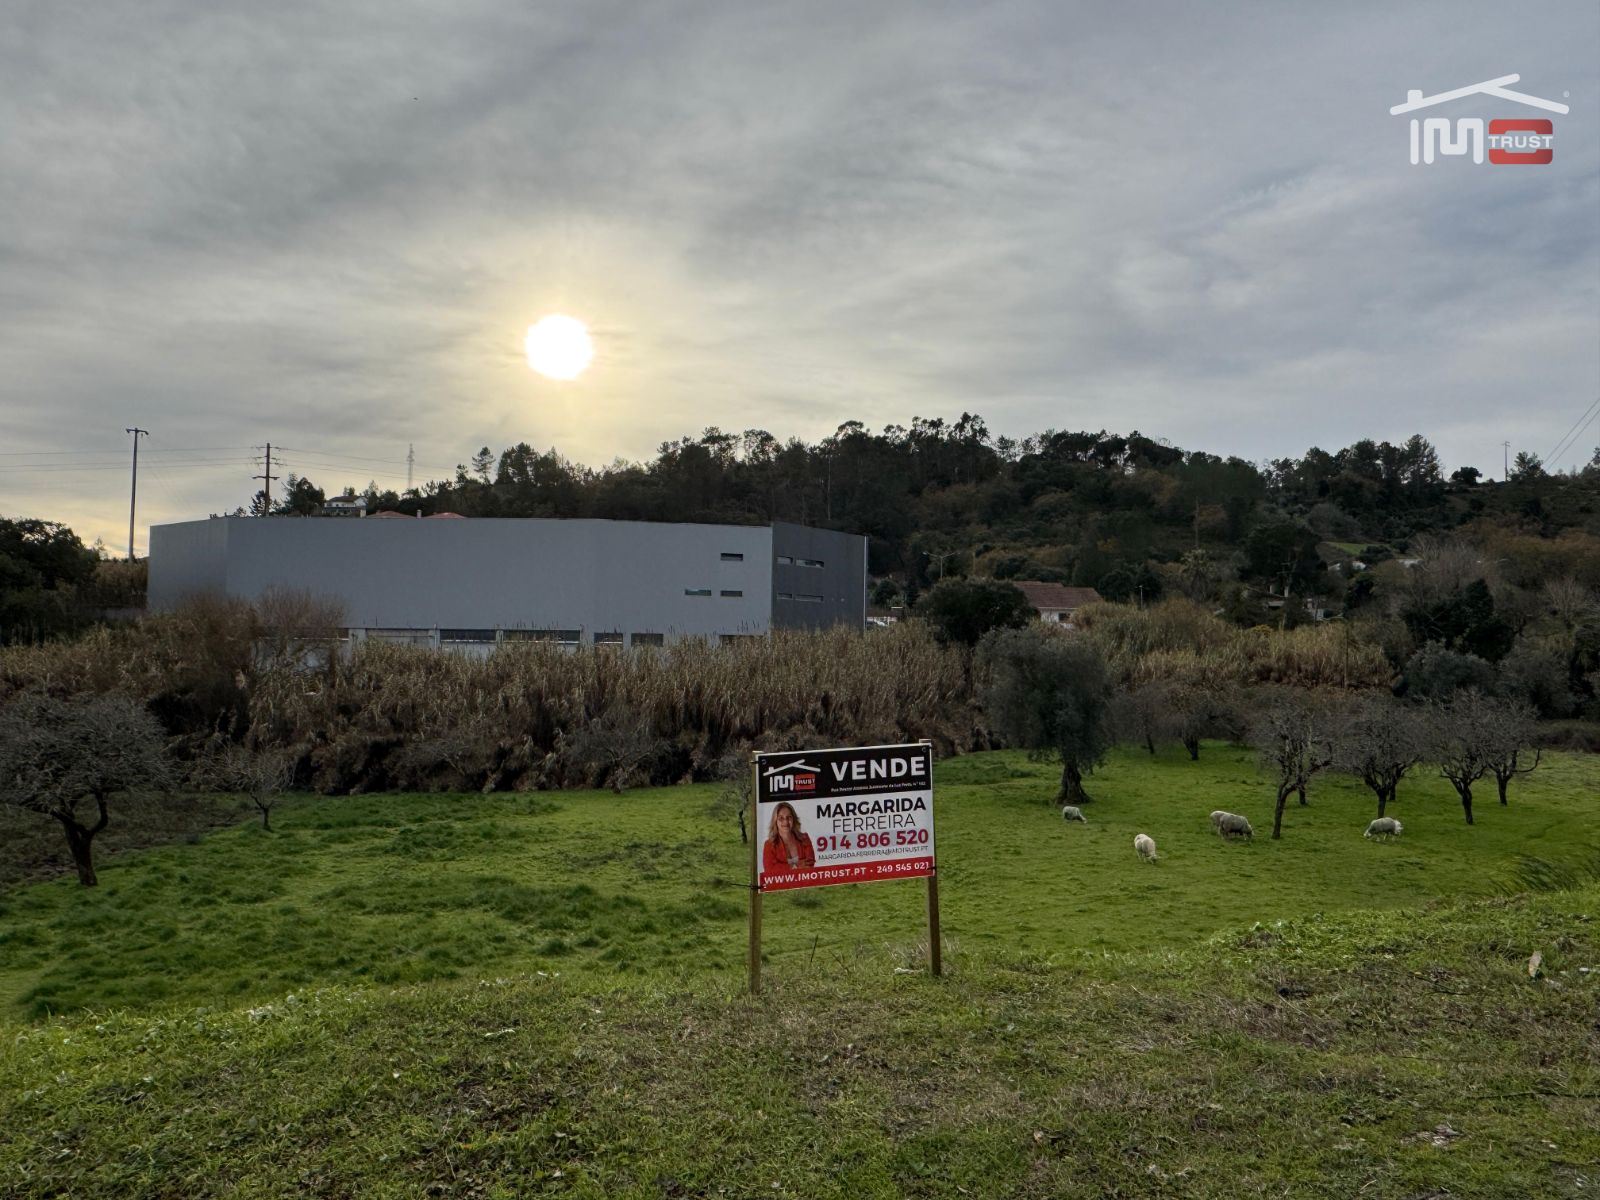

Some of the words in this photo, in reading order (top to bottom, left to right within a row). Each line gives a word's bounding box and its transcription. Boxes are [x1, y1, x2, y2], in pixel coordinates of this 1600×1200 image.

[831, 757, 926, 781] VENDE
[817, 797, 926, 818] MARGARIDA
[832, 814, 916, 833] FERREIRA
[816, 835, 851, 852] 914
[857, 832, 891, 849] 806
[896, 829, 928, 845] 520
[764, 867, 866, 884] WWW.IMOTRUST.PT
[877, 864, 893, 873] 249
[895, 862, 912, 872] 545
[914, 861, 928, 871] 021
